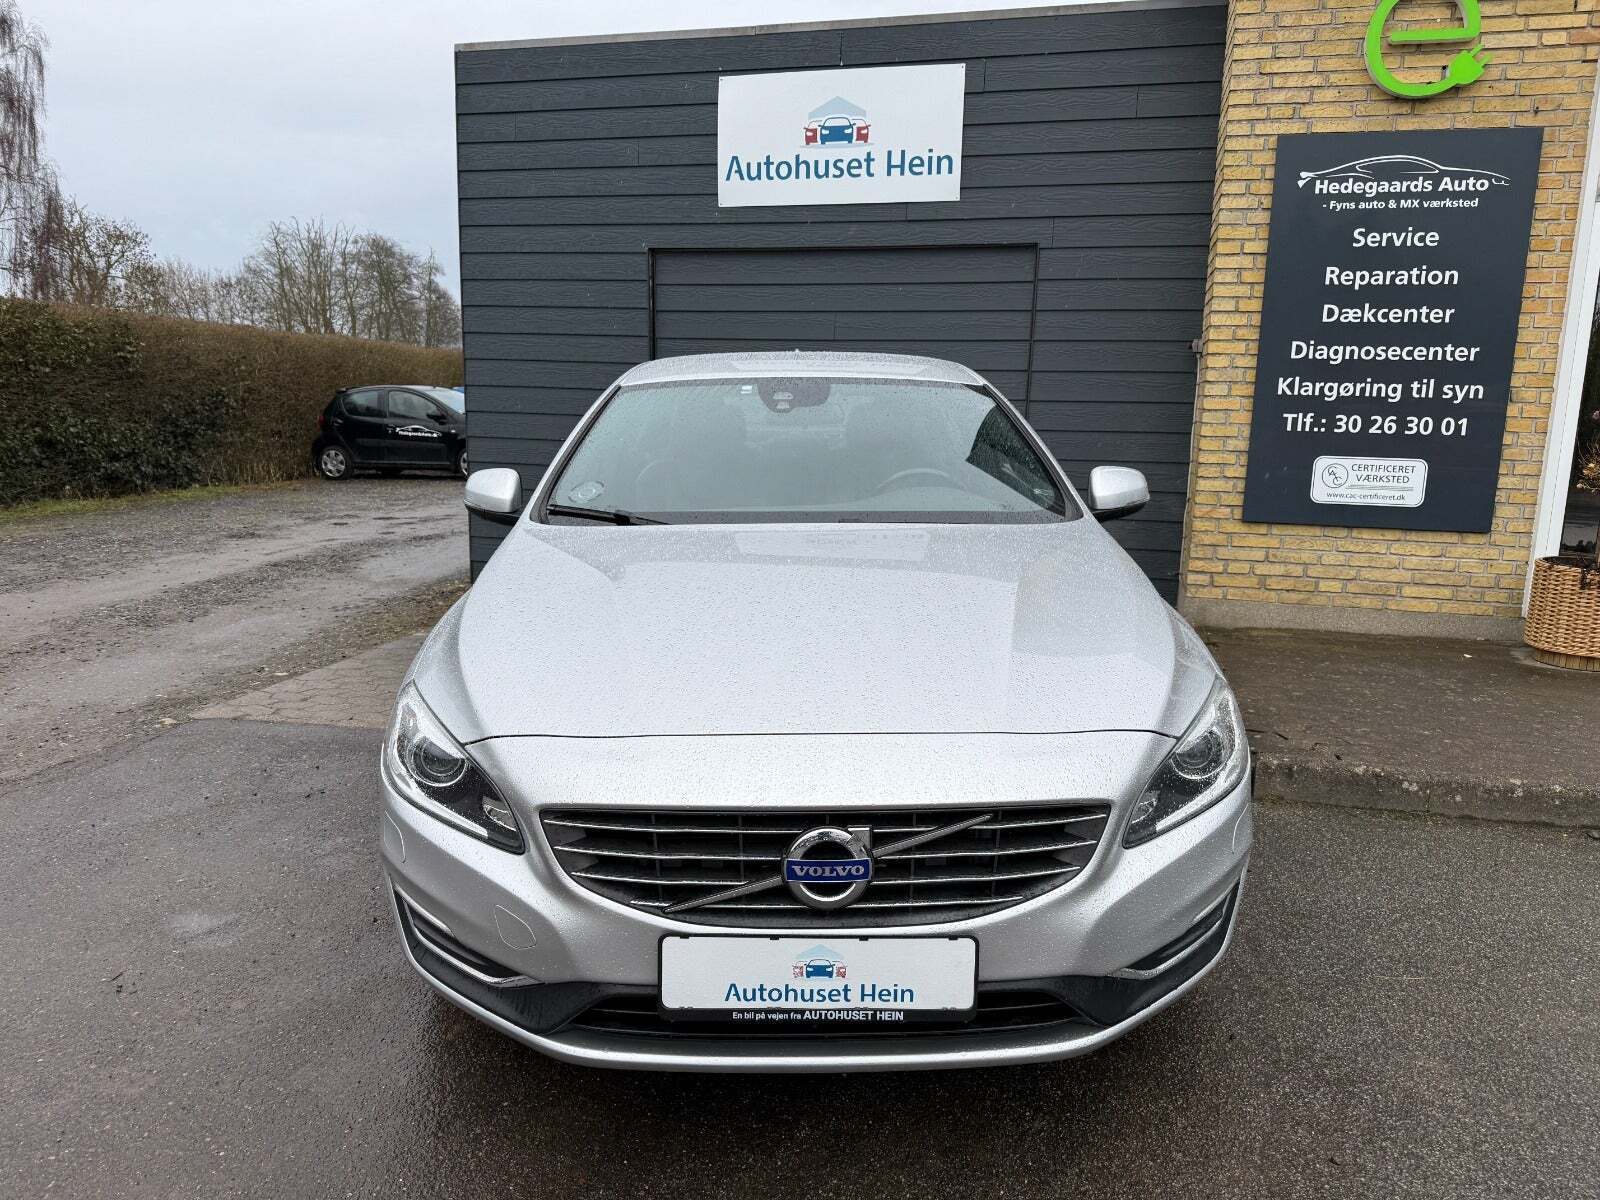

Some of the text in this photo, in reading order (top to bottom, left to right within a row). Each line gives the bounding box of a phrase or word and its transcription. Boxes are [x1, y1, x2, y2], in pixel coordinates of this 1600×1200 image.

[726, 148, 953, 181] Autohuset Hein
[1315, 176, 1489, 197] Hedegaards Auto
[1329, 201, 1356, 211] Fyns
[1359, 200, 1385, 209] auto
[1388, 200, 1397, 209] &
[1400, 199, 1420, 208] MX
[1423, 198, 1479, 208] værksted
[1352, 227, 1440, 248] Service
[1325, 265, 1459, 290] Reparation
[1322, 303, 1455, 323] Dækcenter
[1290, 340, 1480, 365] Diagnosecenter
[1277, 377, 1484, 403] Klargøring til syn
[1283, 413, 1468, 436] Tlf.: 30 26 30 01
[1351, 464, 1416, 474] CERTIFICERET
[1356, 474, 1410, 484] VÆRKSTED
[792, 865, 864, 877] VOLVO
[725, 983, 914, 1003] Autohuset Hein
[732, 1010, 904, 1022] En bil på vejen fra AUTOHUSET HEIN
